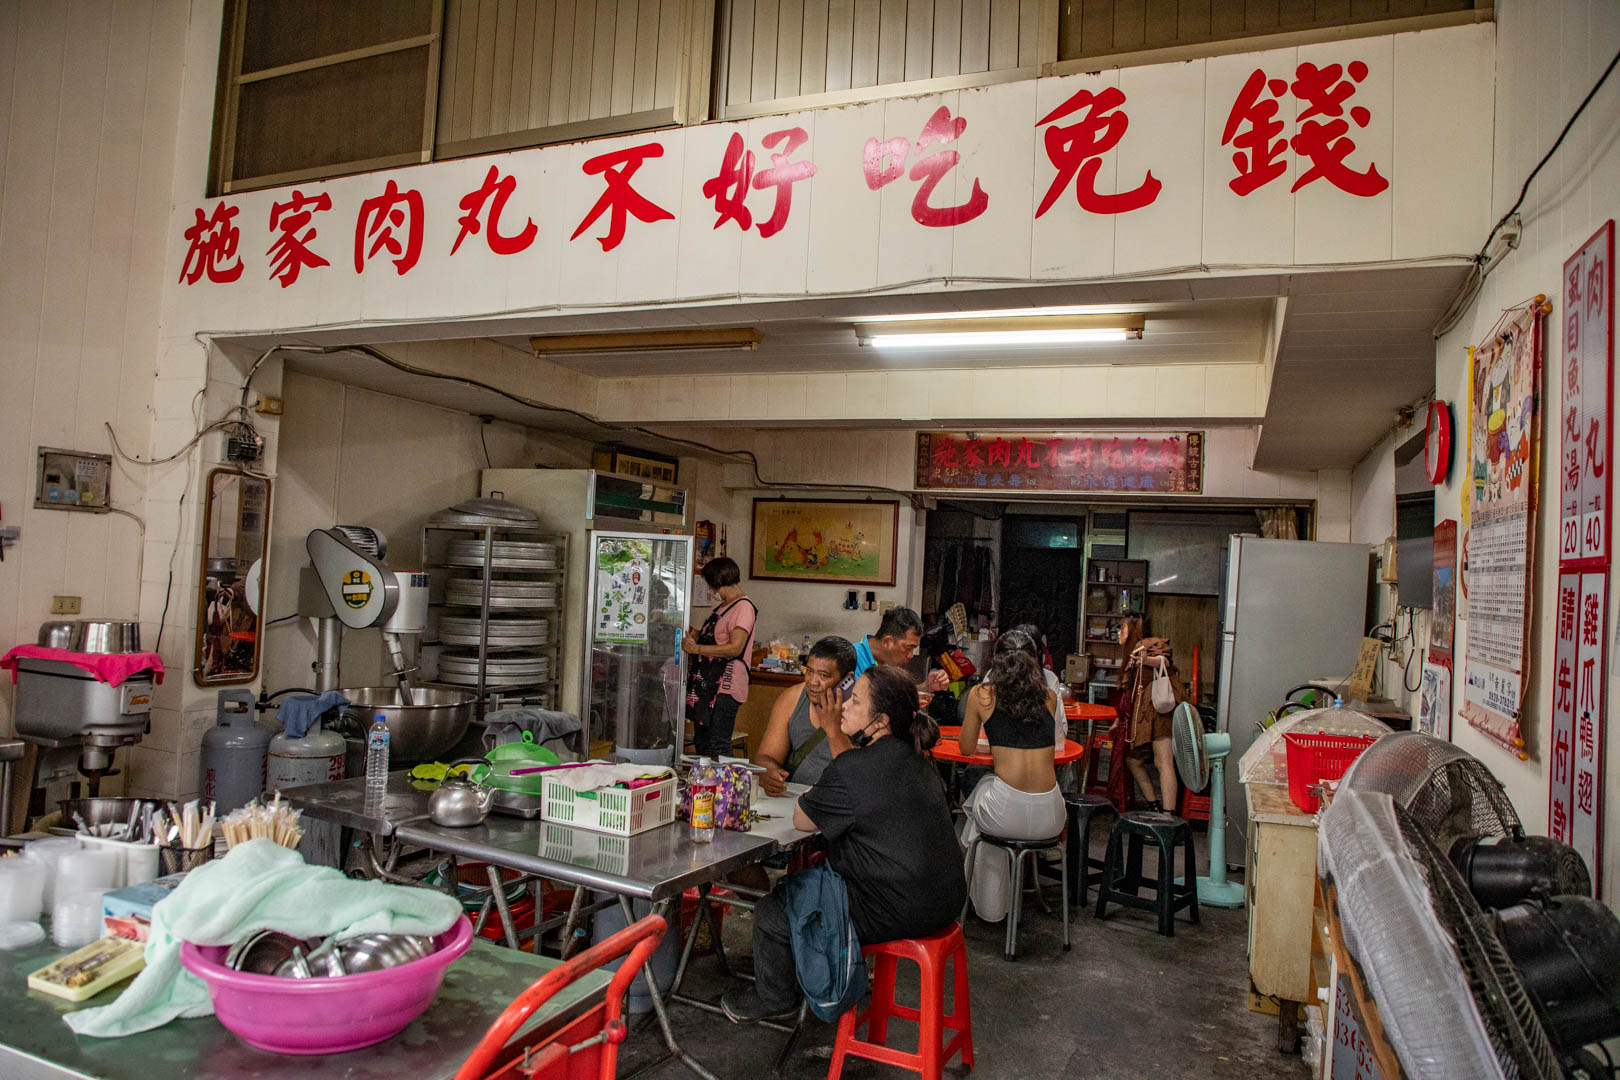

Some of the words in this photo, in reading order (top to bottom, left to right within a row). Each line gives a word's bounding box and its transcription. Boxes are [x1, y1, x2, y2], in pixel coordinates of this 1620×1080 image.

[178, 60, 1389, 288] 施家肉丸不好吃免錢
[1565, 264, 1581, 492] 虱目魚丸湯
[1187, 435, 1200, 491] 傳統古早味
[1564, 521, 1577, 553] 20
[1585, 516, 1600, 552] 40
